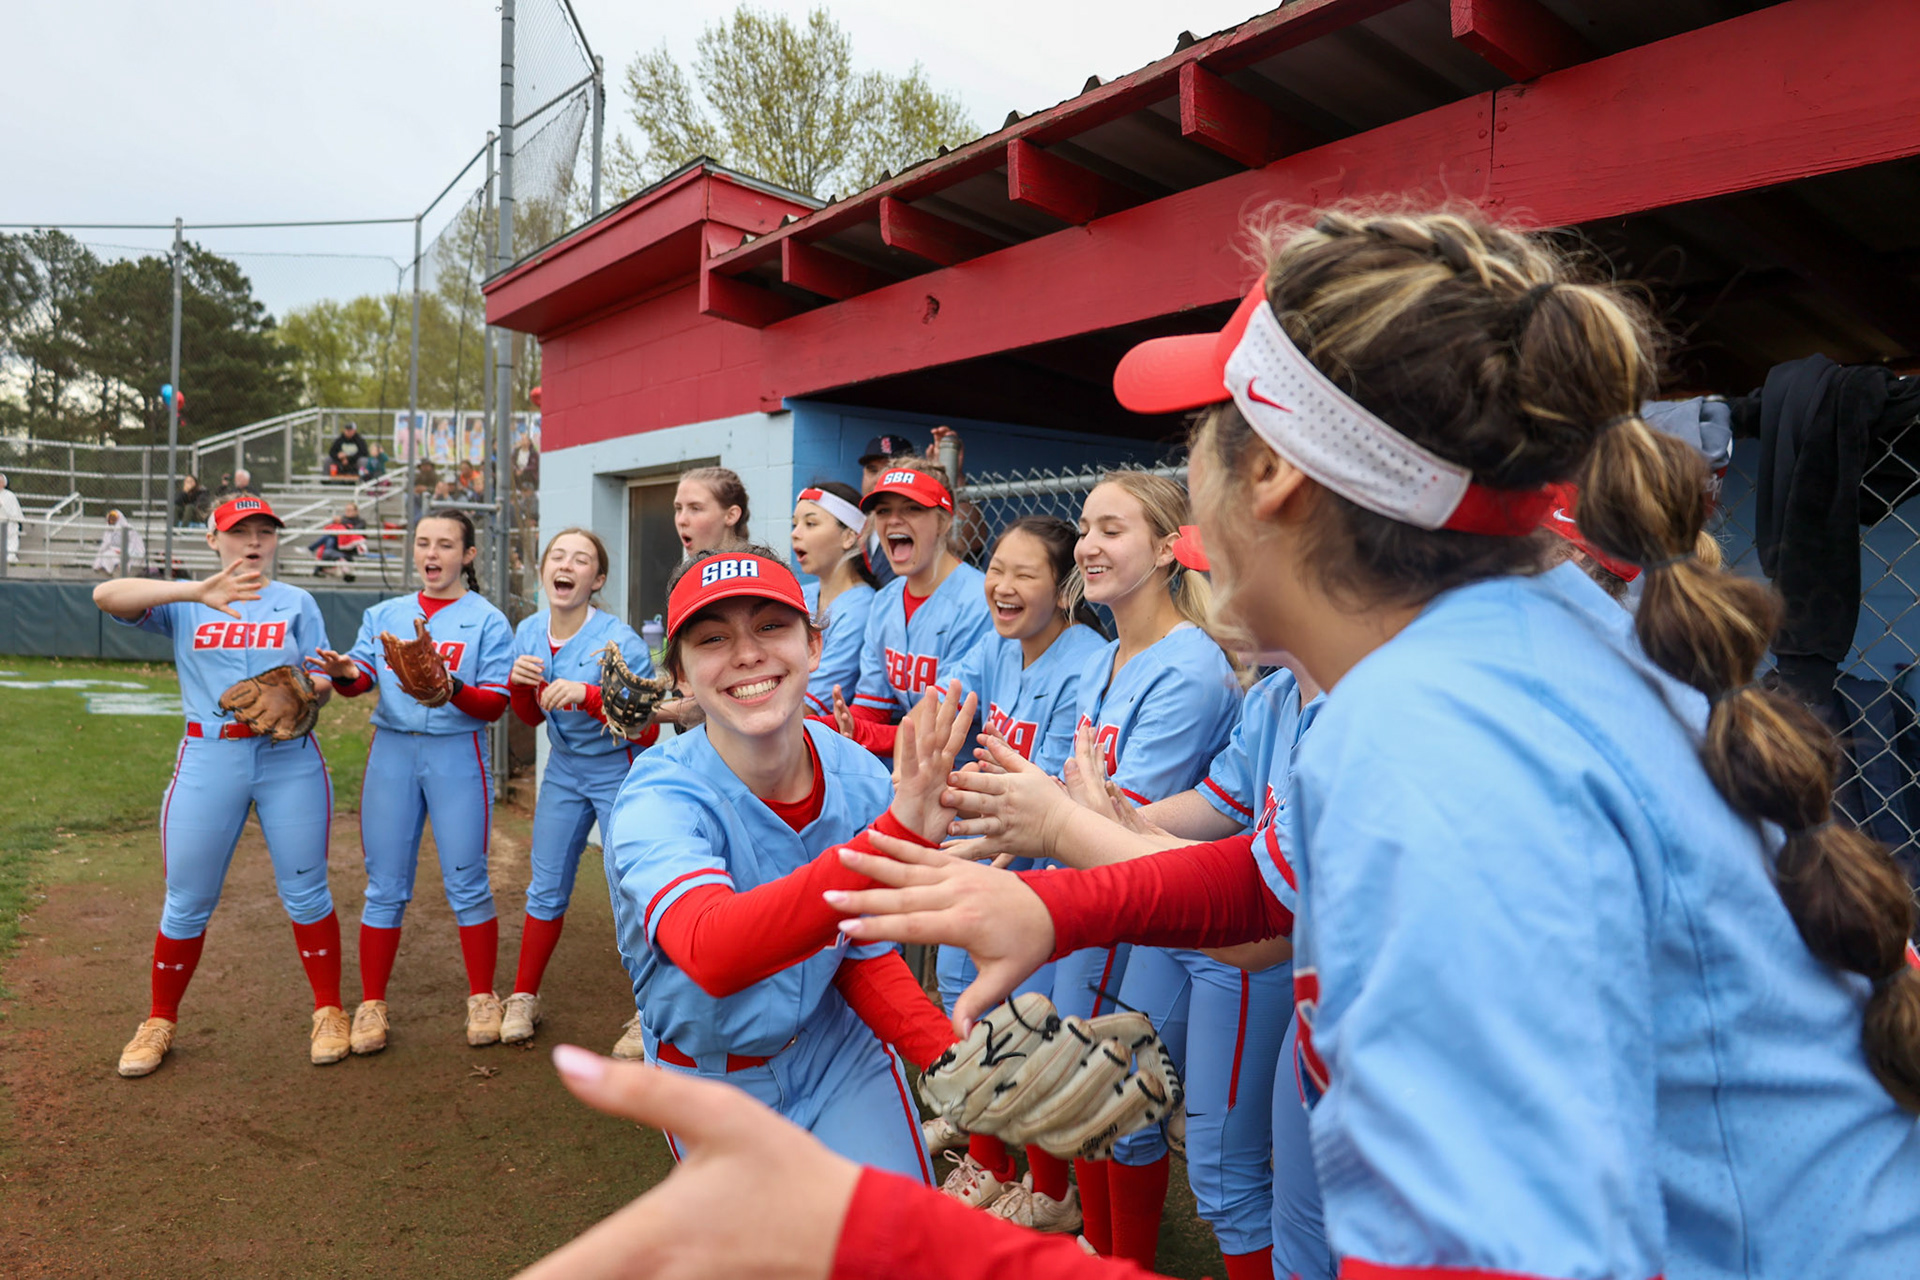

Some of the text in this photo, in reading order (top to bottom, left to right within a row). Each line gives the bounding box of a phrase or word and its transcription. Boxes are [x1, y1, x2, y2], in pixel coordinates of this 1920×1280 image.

[881, 471, 915, 485] SBA
[701, 559, 759, 588] SBA
[193, 620, 288, 651] SBA
